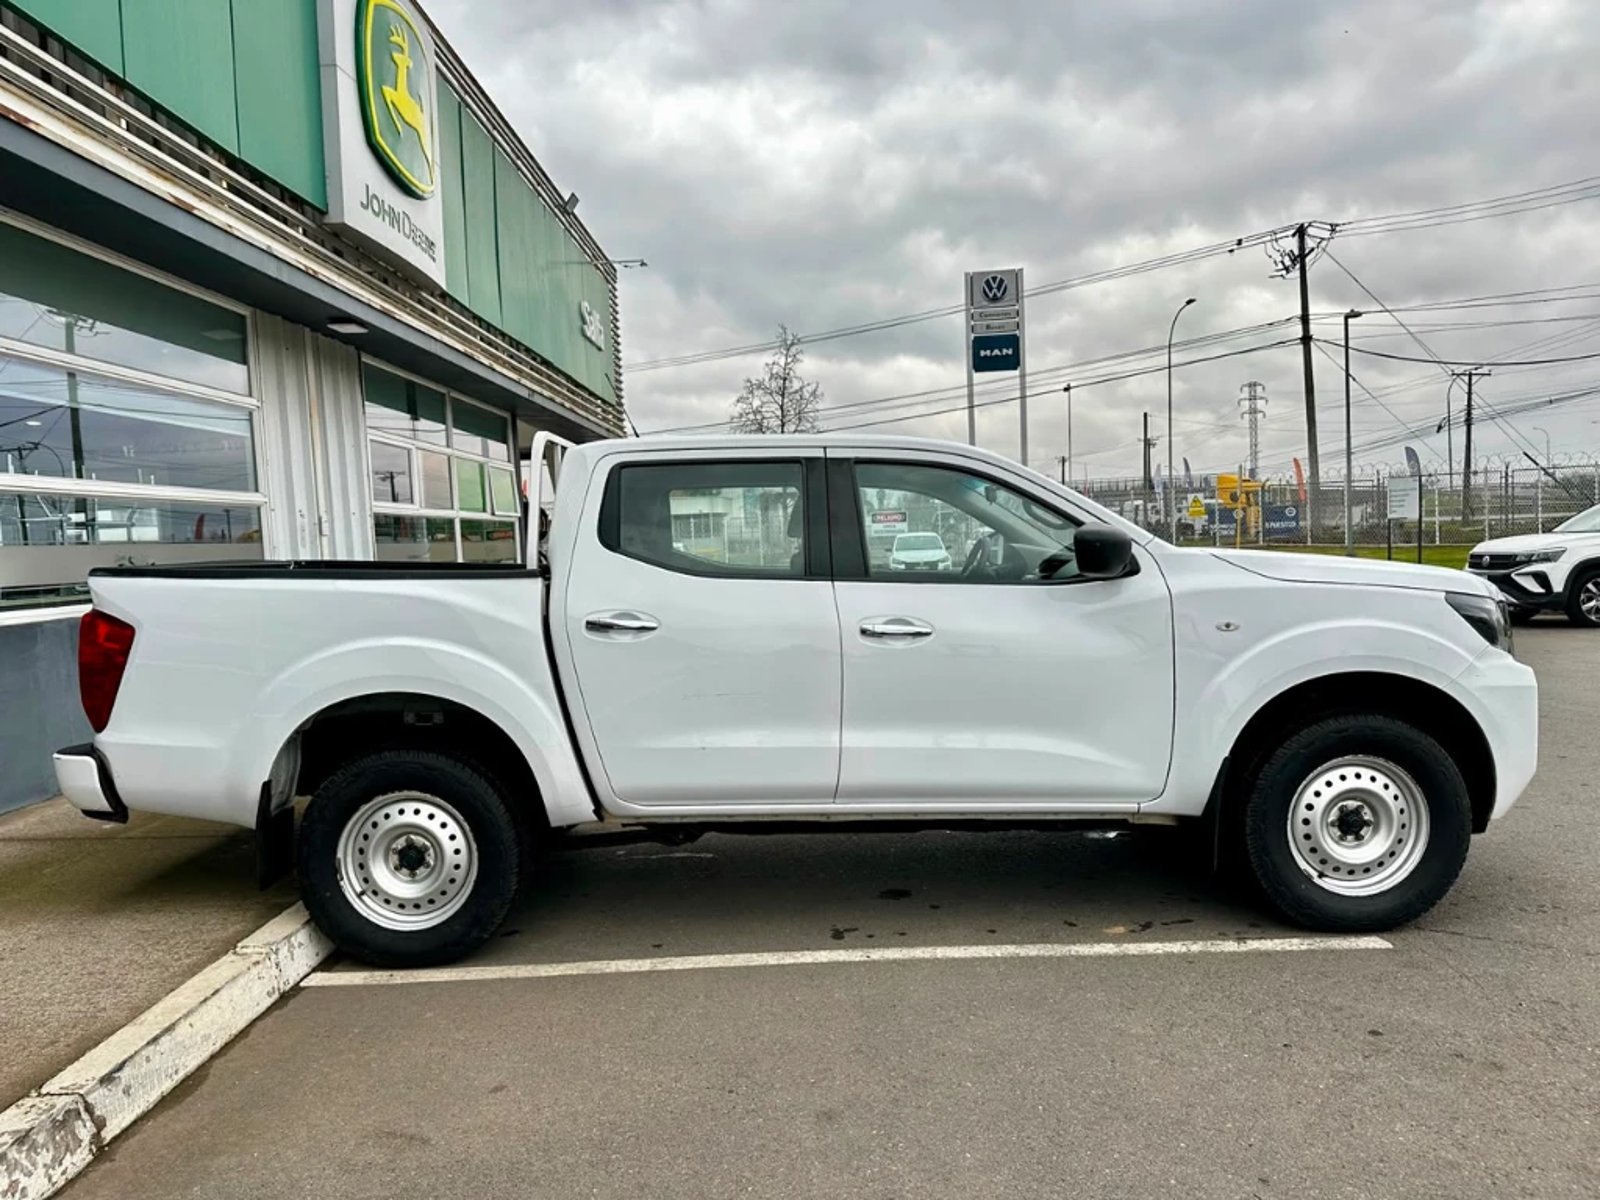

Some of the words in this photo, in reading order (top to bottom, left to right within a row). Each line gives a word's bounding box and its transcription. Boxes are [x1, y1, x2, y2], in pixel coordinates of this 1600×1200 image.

[360, 183, 401, 234] JOHN
[402, 210, 437, 263] DEERE
[980, 348, 1013, 357] MAN
